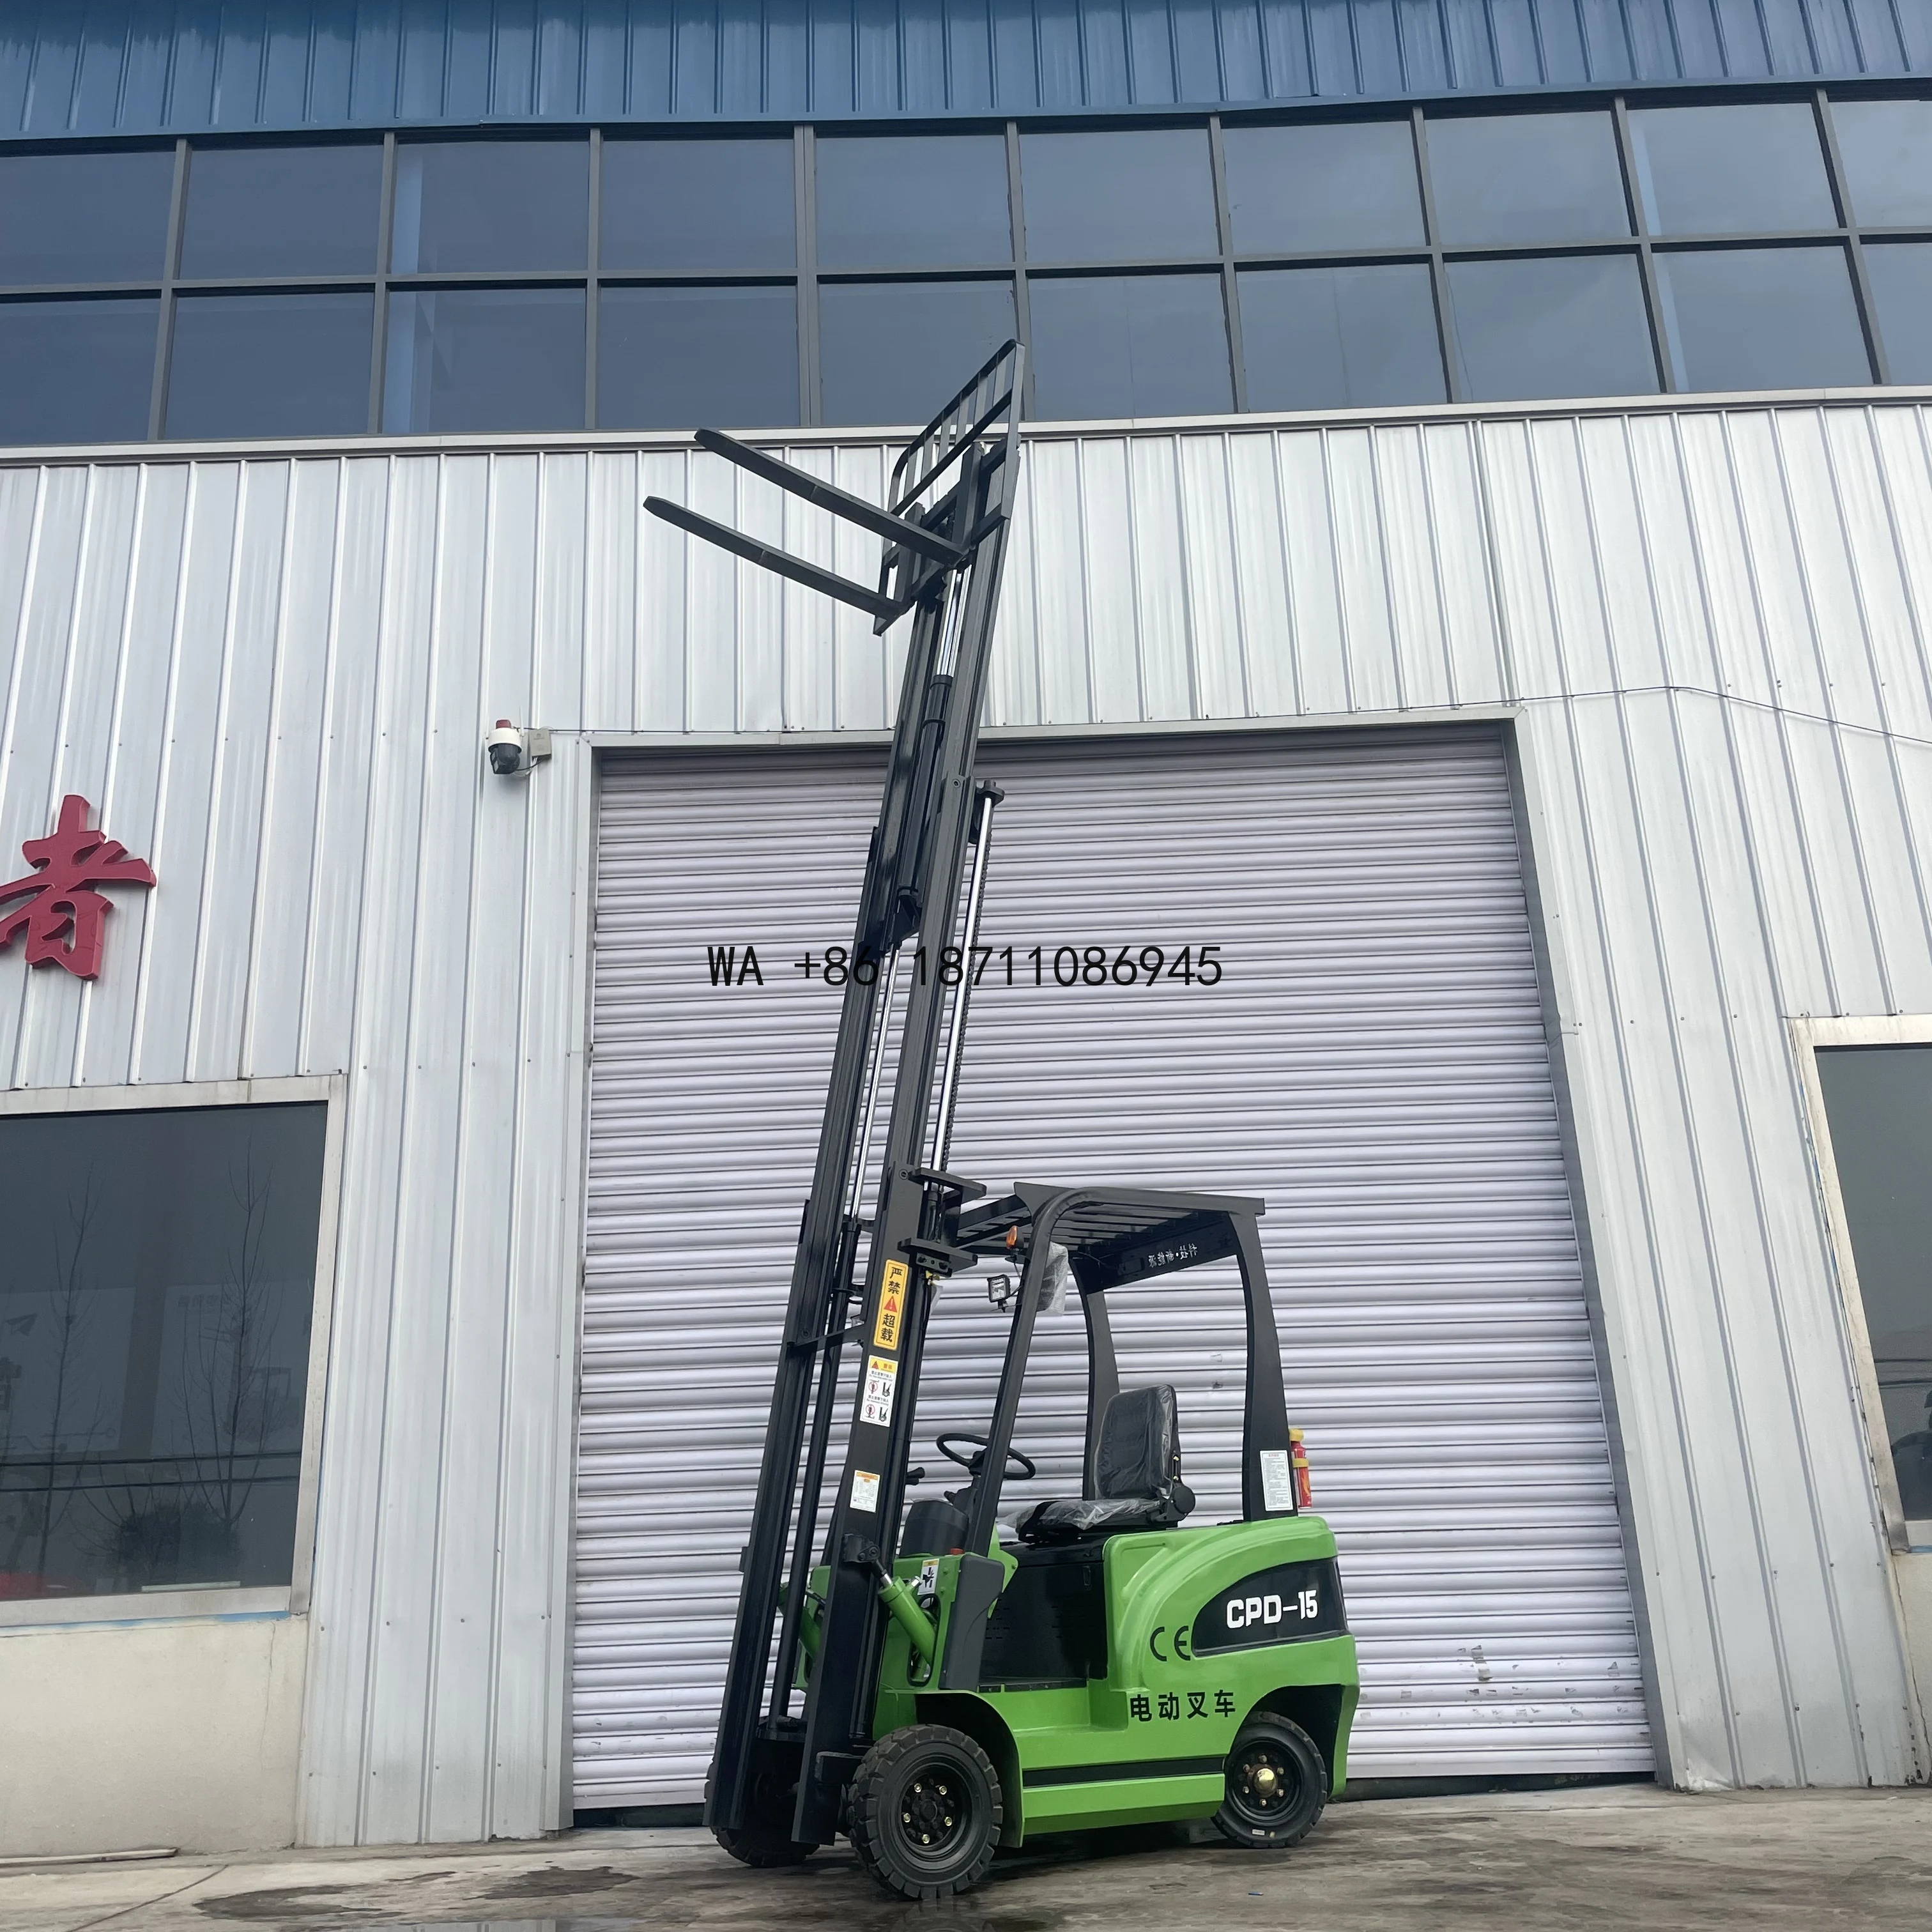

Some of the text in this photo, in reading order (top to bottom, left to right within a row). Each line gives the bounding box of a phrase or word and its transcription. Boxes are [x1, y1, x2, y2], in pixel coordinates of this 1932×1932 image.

[0, 793, 157, 981] 者
[880, 1266, 903, 1343] 严禁 超载
[1226, 1590, 1319, 1629] CPD-15
[1149, 1625, 1192, 1662] CE
[1130, 1689, 1236, 1722] 电动叉车
